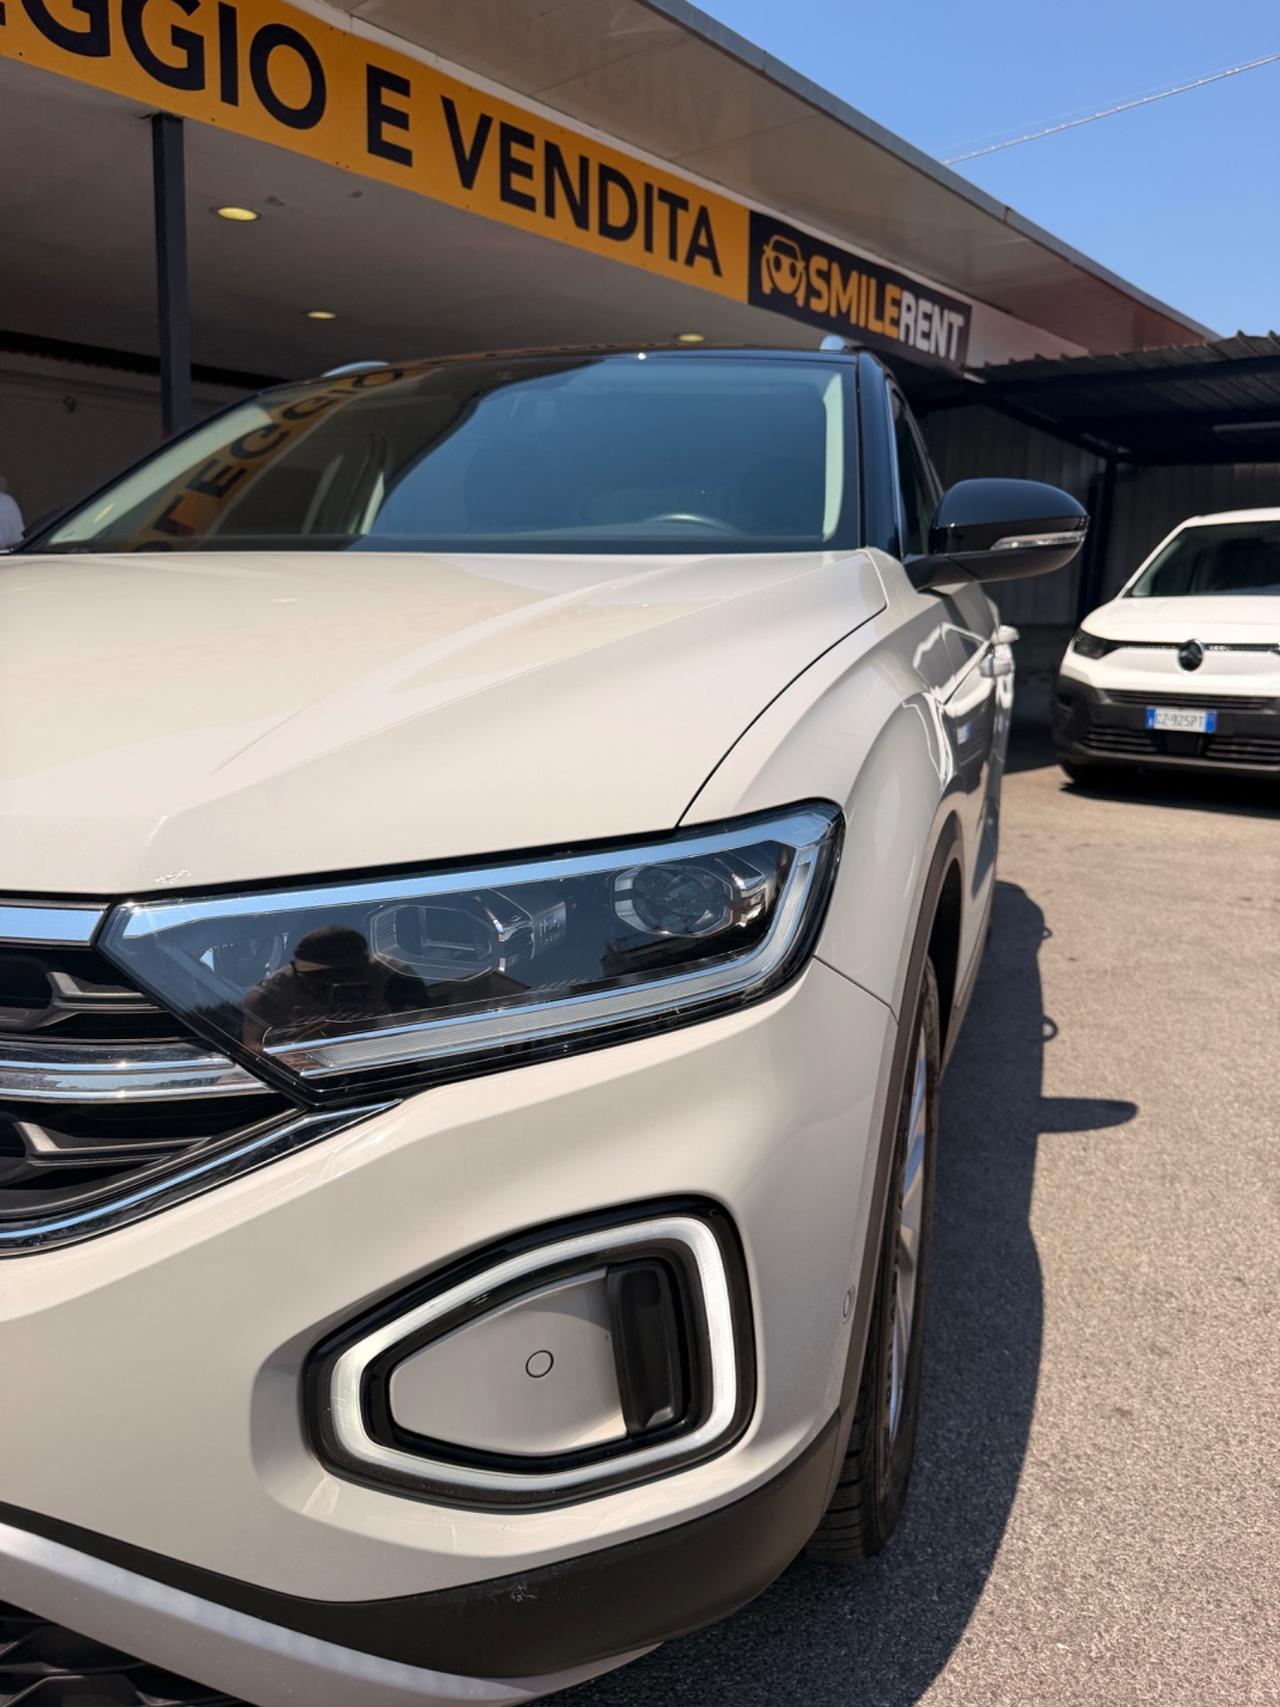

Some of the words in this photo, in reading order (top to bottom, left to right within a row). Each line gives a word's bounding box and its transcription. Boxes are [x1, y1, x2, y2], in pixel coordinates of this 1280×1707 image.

[0, 0, 326, 130] GGIO
[366, 63, 412, 168] E
[441, 95, 723, 278] VENDITA
